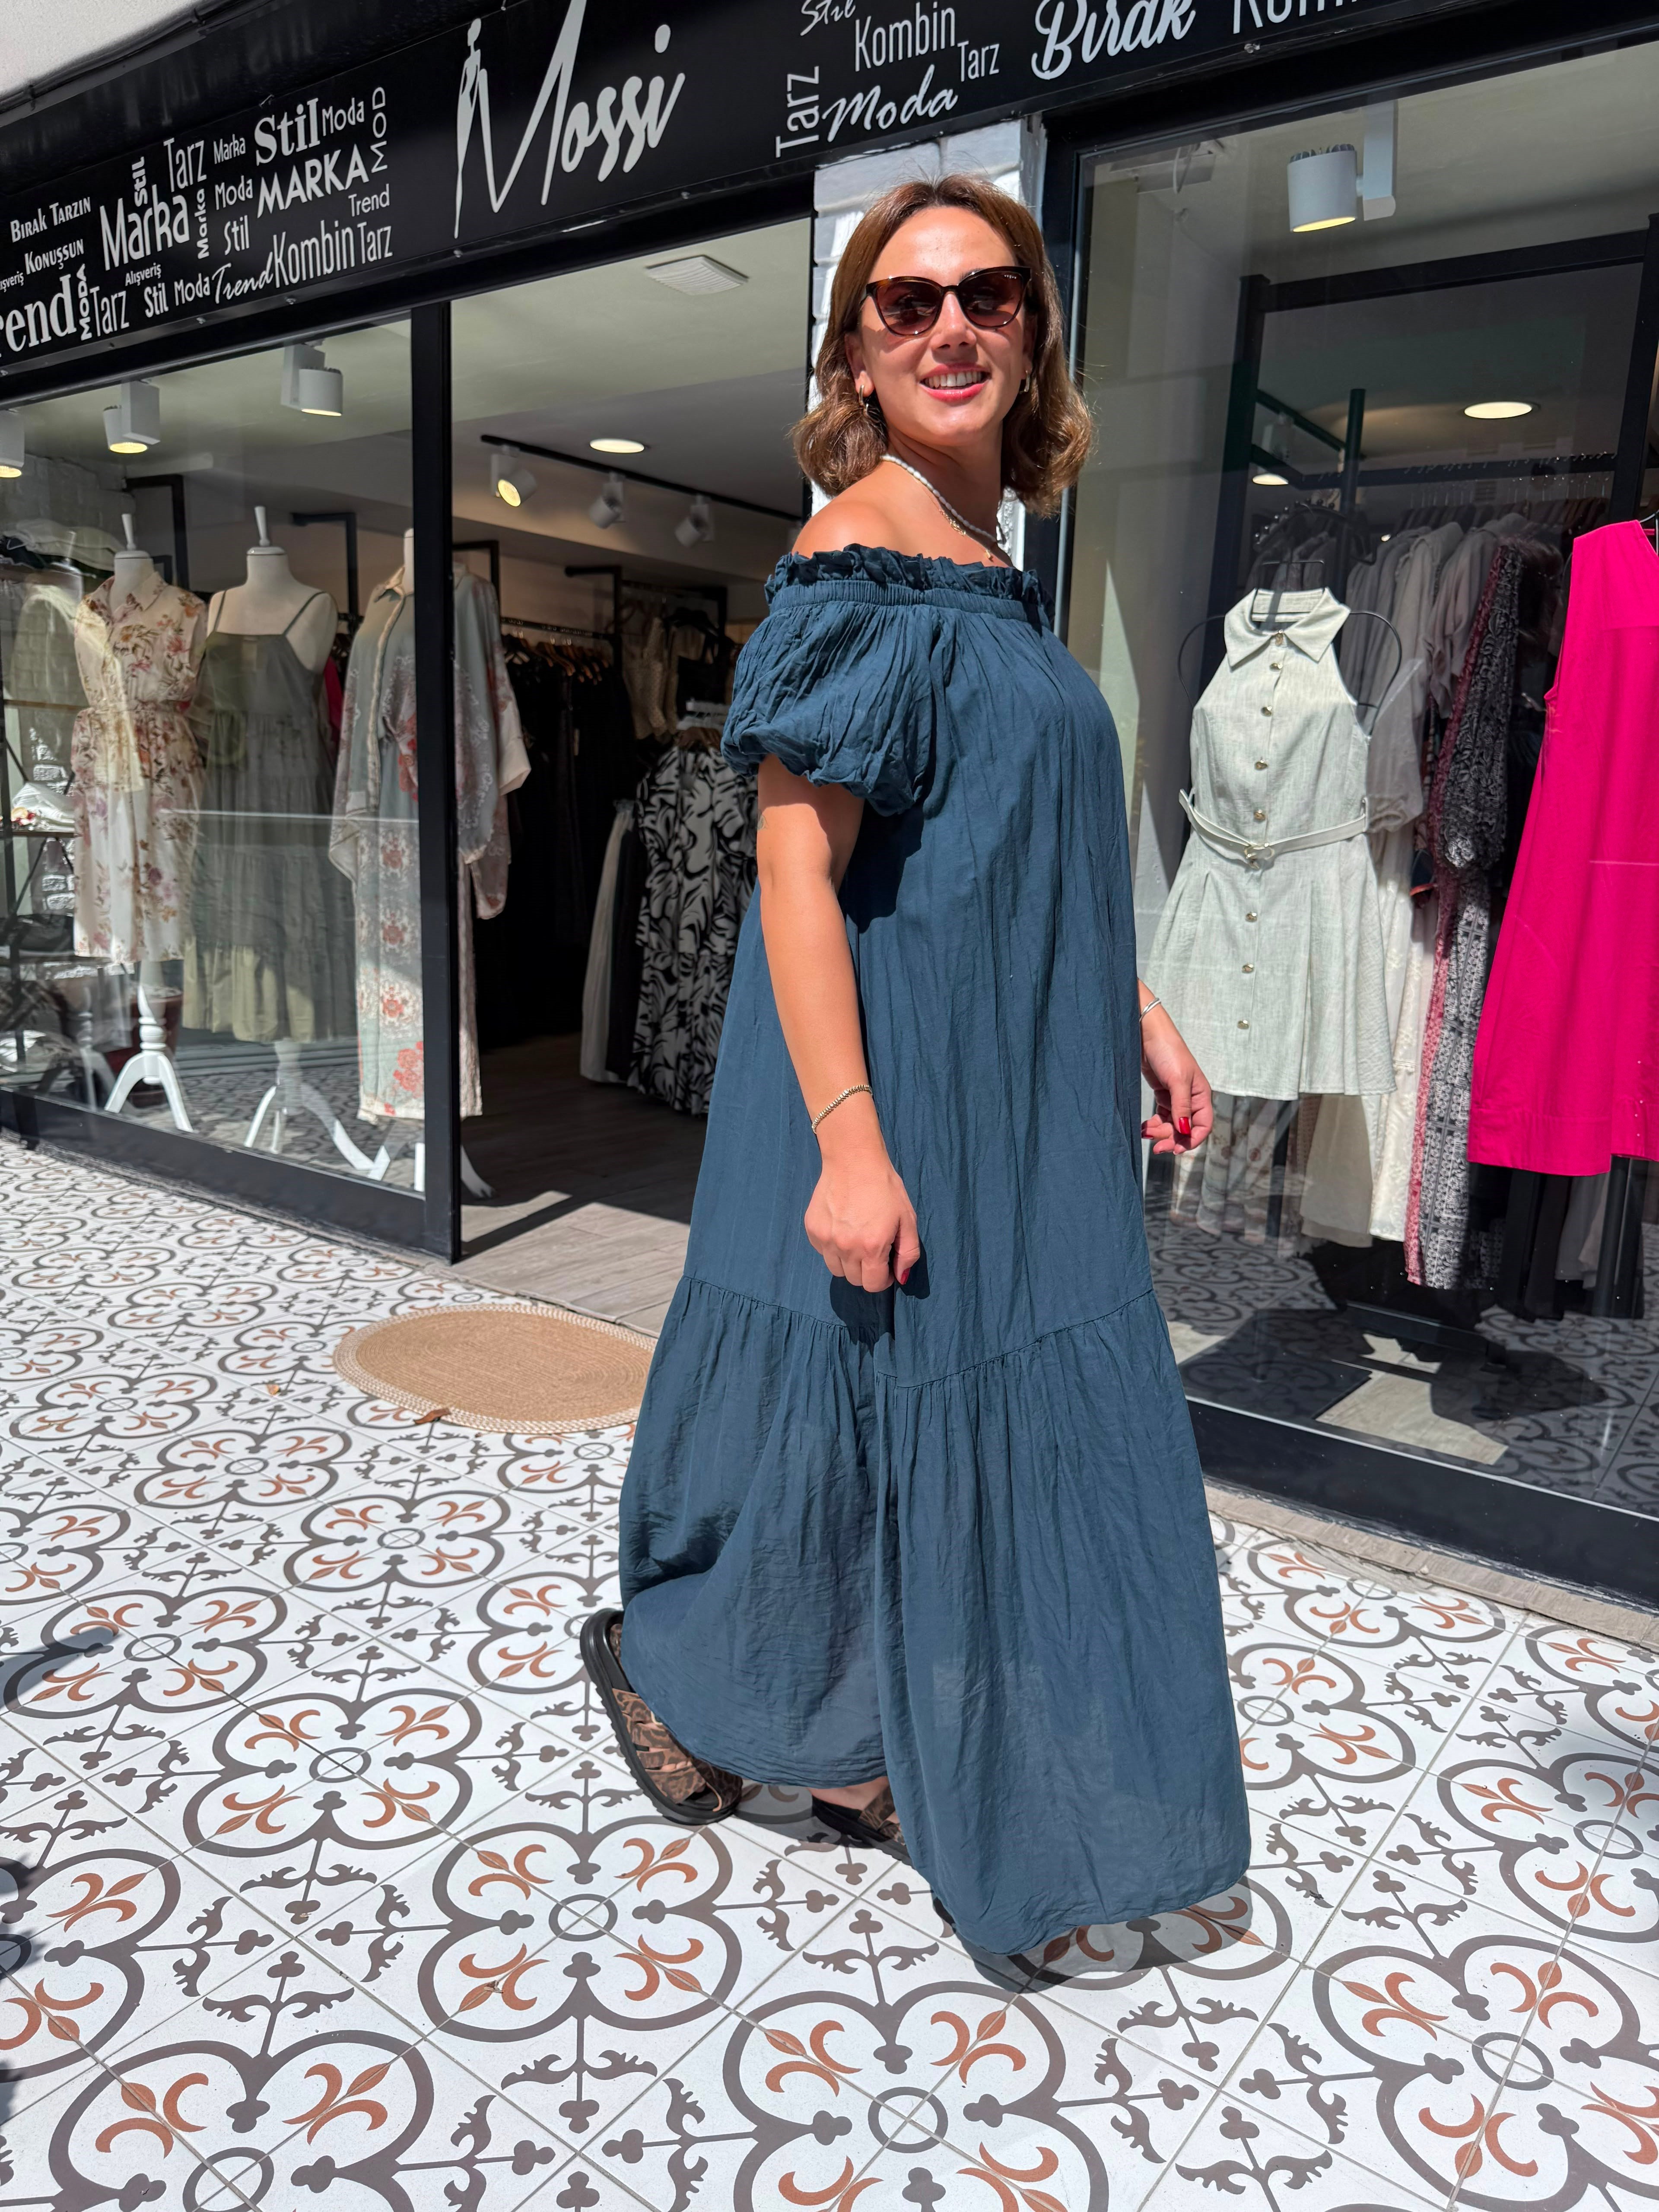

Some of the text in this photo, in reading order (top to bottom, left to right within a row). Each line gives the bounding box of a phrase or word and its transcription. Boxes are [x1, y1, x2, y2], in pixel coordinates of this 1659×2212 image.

[855, 2, 955, 72] Kombin
[957, 41, 999, 82] Tarz
[322, 98, 364, 136] Moda
[370, 87, 388, 173] MOD
[454, 0, 685, 239] Mossi
[776, 66, 819, 158] Tarz
[822, 64, 959, 142] Moda
[213, 134, 246, 164] Marka
[254, 98, 320, 166] Stil
[163, 137, 207, 192] Tarz
[257, 143, 369, 218] MARKA
[215, 175, 253, 210] Moda
[348, 184, 390, 217] Trend
[100, 184, 190, 271] Marka
[197, 188, 210, 259] Marka
[223, 215, 250, 255] Stil
[357, 222, 393, 264] Tarz
[125, 262, 162, 286] Alışveriş
[212, 251, 273, 304] Trend
[273, 220, 355, 288] Kombin
[0, 270, 24, 293] ışveriş
[76, 263, 92, 341] MODA
[143, 273, 210, 318] Stil Moda
[89, 286, 130, 337] Tarz
